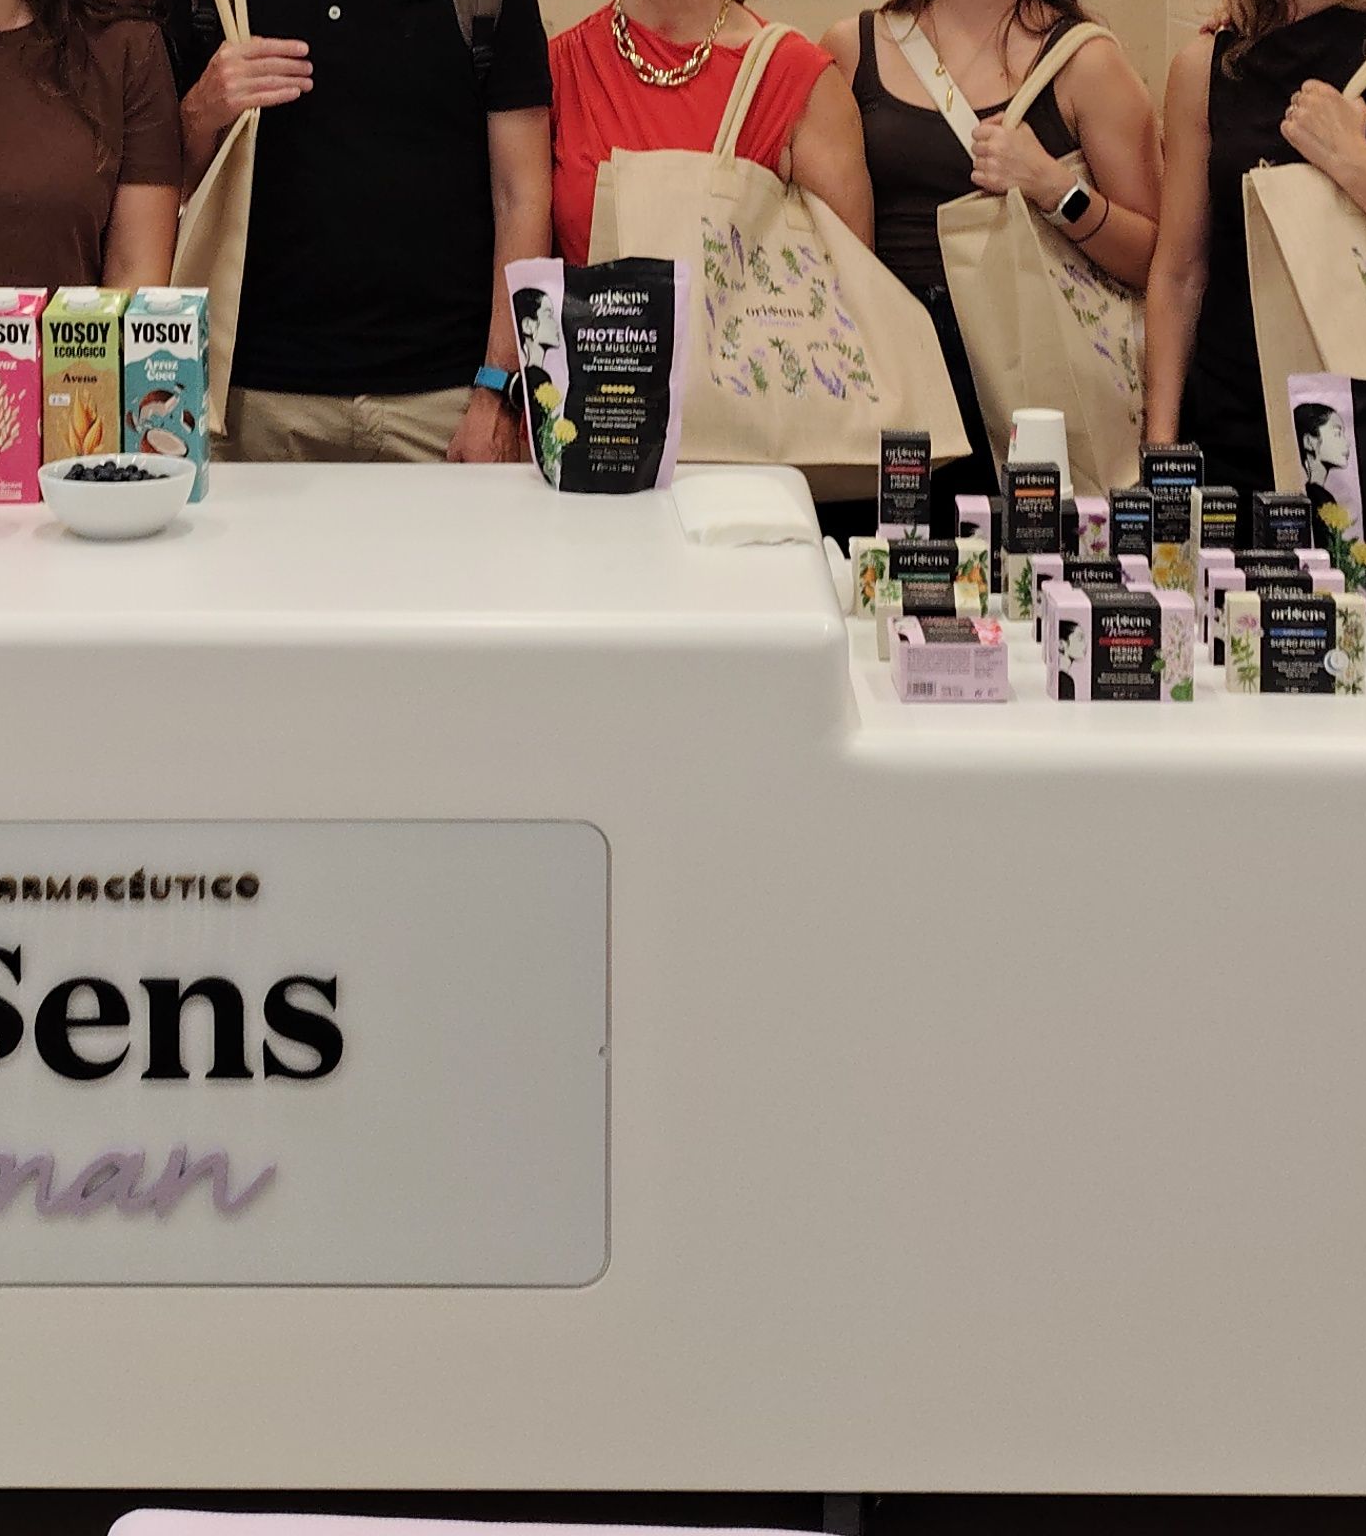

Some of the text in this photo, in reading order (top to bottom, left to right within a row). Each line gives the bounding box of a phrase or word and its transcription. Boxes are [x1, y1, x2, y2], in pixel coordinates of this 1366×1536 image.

[49, 322, 111, 344] YOSOY
[131, 323, 192, 344] YOSOY
[577, 325, 658, 344] PROTEÍNAS
[143, 359, 180, 371] Arroz
[62, 373, 98, 383] Avena
[146, 370, 177, 382] Coco
